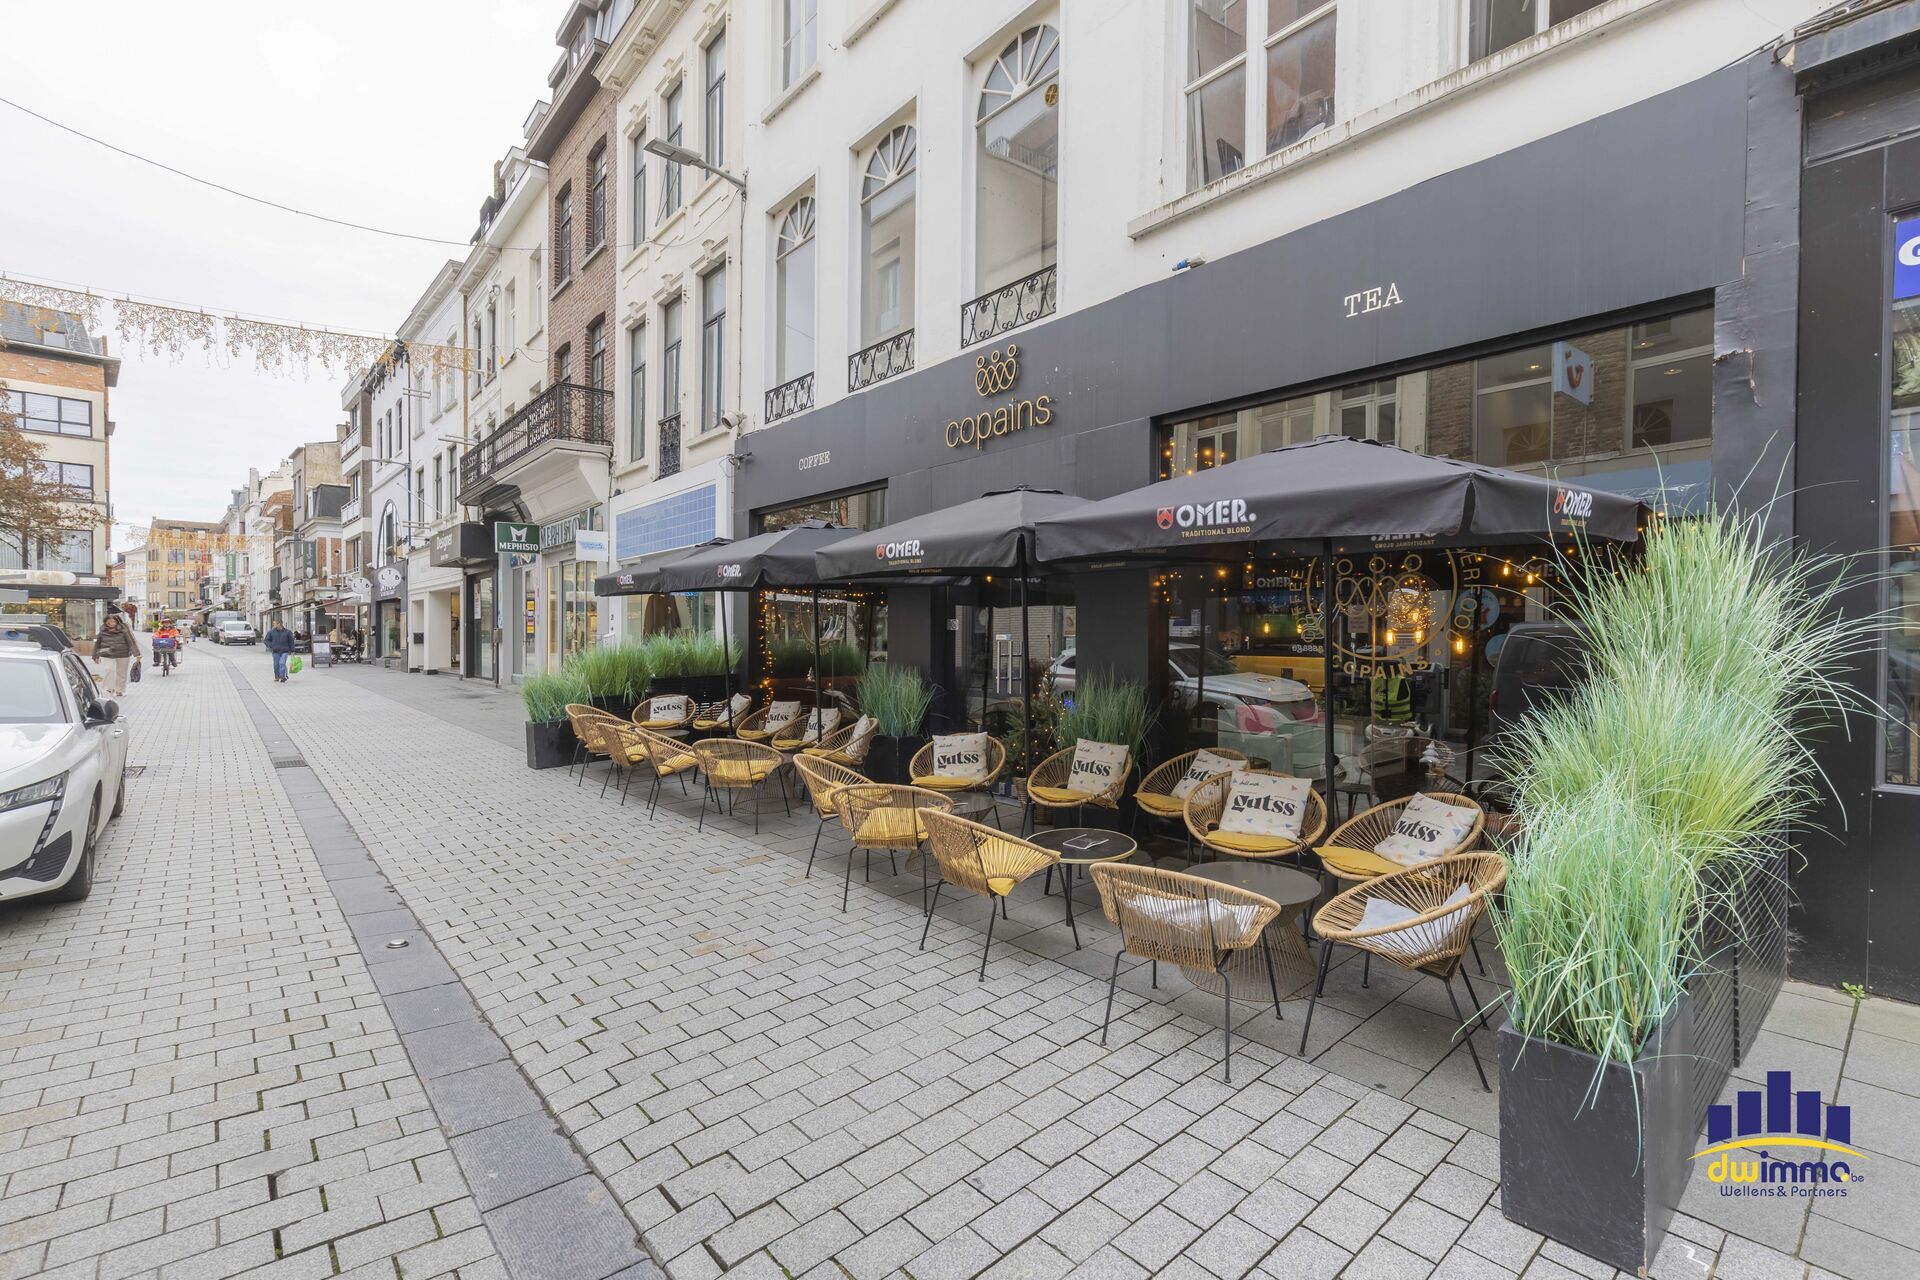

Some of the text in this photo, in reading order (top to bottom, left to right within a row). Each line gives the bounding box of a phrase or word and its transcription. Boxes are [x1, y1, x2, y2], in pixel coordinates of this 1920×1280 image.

[1343, 282, 1403, 318] TEA
[945, 395, 1052, 450] copains
[798, 450, 831, 471] COFFEE
[1181, 526, 1251, 538] TRADITIONAL BLOND
[499, 542, 539, 551] MEPHISTO
[937, 751, 979, 769] gutss
[1072, 759, 1112, 777] gutss
[1231, 794, 1297, 817] gutss
